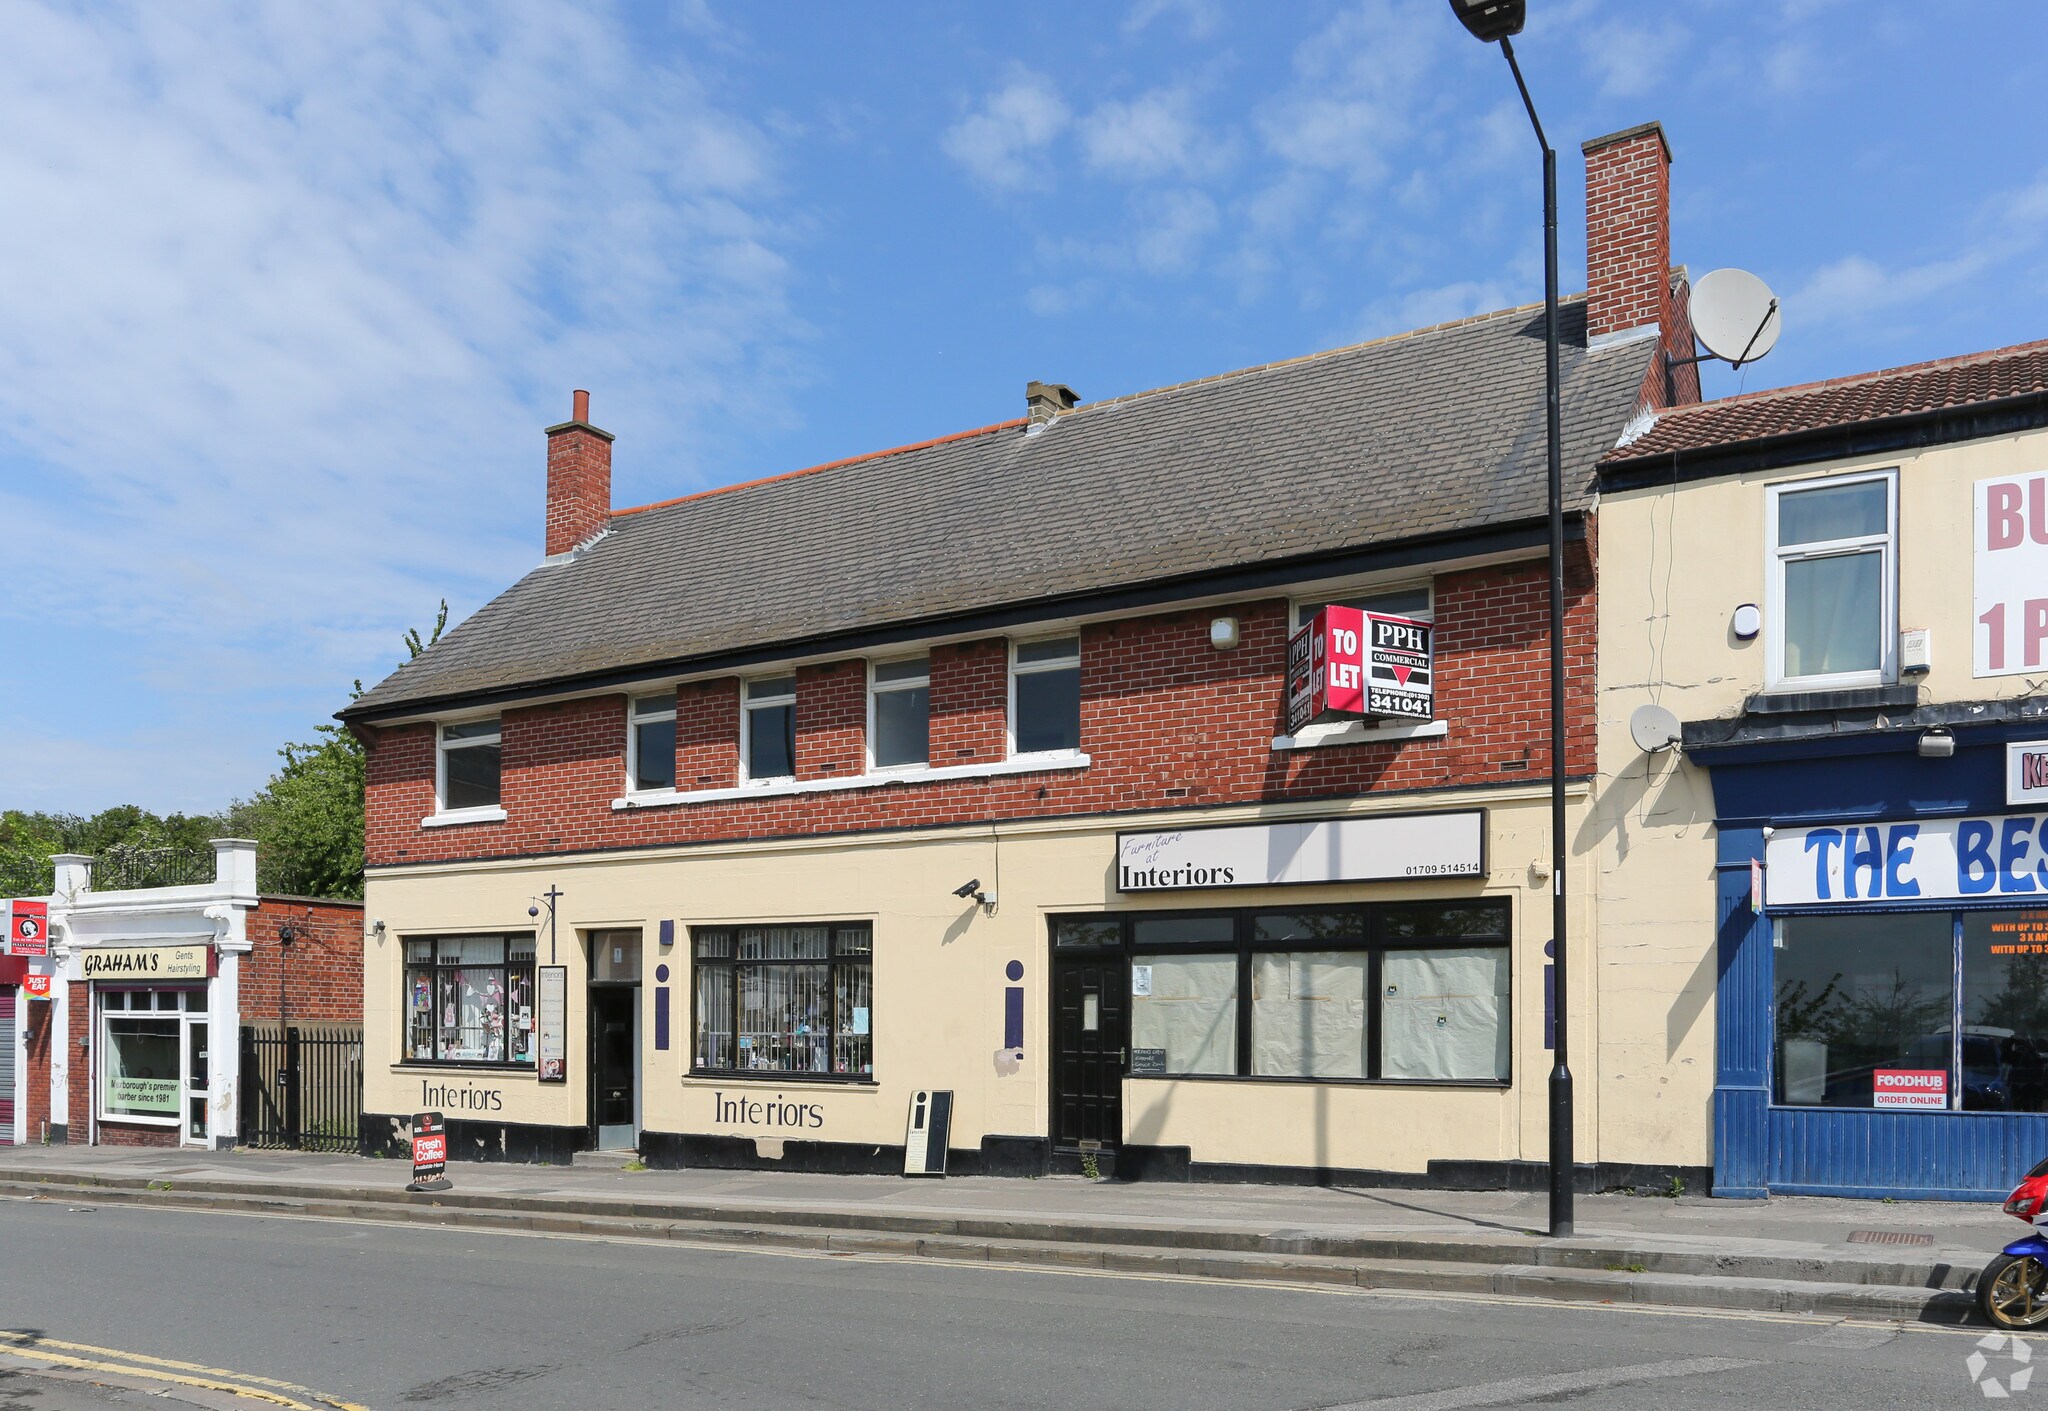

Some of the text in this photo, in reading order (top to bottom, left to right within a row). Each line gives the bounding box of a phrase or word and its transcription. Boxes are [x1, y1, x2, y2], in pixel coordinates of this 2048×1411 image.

[1332, 628, 1357, 656] TO
[1377, 624, 1423, 650] PPH
[1979, 602, 2005, 670] 1
[1292, 633, 1308, 665] PPH
[1314, 633, 1324, 661] TO
[1374, 653, 1427, 667] COMMERCIAL
[1313, 665, 1324, 695] LET
[1330, 662, 1360, 689] LET
[1371, 694, 1430, 714] 341041
[1291, 701, 1310, 727] 341041
[1121, 833, 1183, 858] Furniture
[1146, 850, 1159, 863] at
[1804, 824, 1921, 900] THE
[1122, 862, 1234, 887] Interiors
[1406, 863, 1479, 875] 01709 514514
[1992, 923, 2016, 932] WITH
[2017, 922, 2030, 932] UP
[2032, 922, 2043, 931] TO
[2019, 933, 2026, 942] 3
[2027, 933, 2034, 941] X
[175, 951, 193, 960] Gents
[1991, 945, 2015, 954] WITH
[2017, 944, 2029, 954] UP
[2031, 944, 2043, 953] TO
[84, 952, 159, 976] GRAHAM'S
[167, 964, 201, 974] Hairstyling
[28, 977, 46, 985] JUST
[153, 1082, 177, 1092] premier
[1877, 1075, 1943, 1087] FOODHUB
[117, 1092, 170, 1103] barber since 1981
[422, 1080, 502, 1111] Interiors
[1878, 1096, 1943, 1105] ORDER ONLINE
[715, 1092, 824, 1128] Interiors
[416, 1138, 442, 1151] Fresh
[416, 1149, 444, 1162] Coffee
